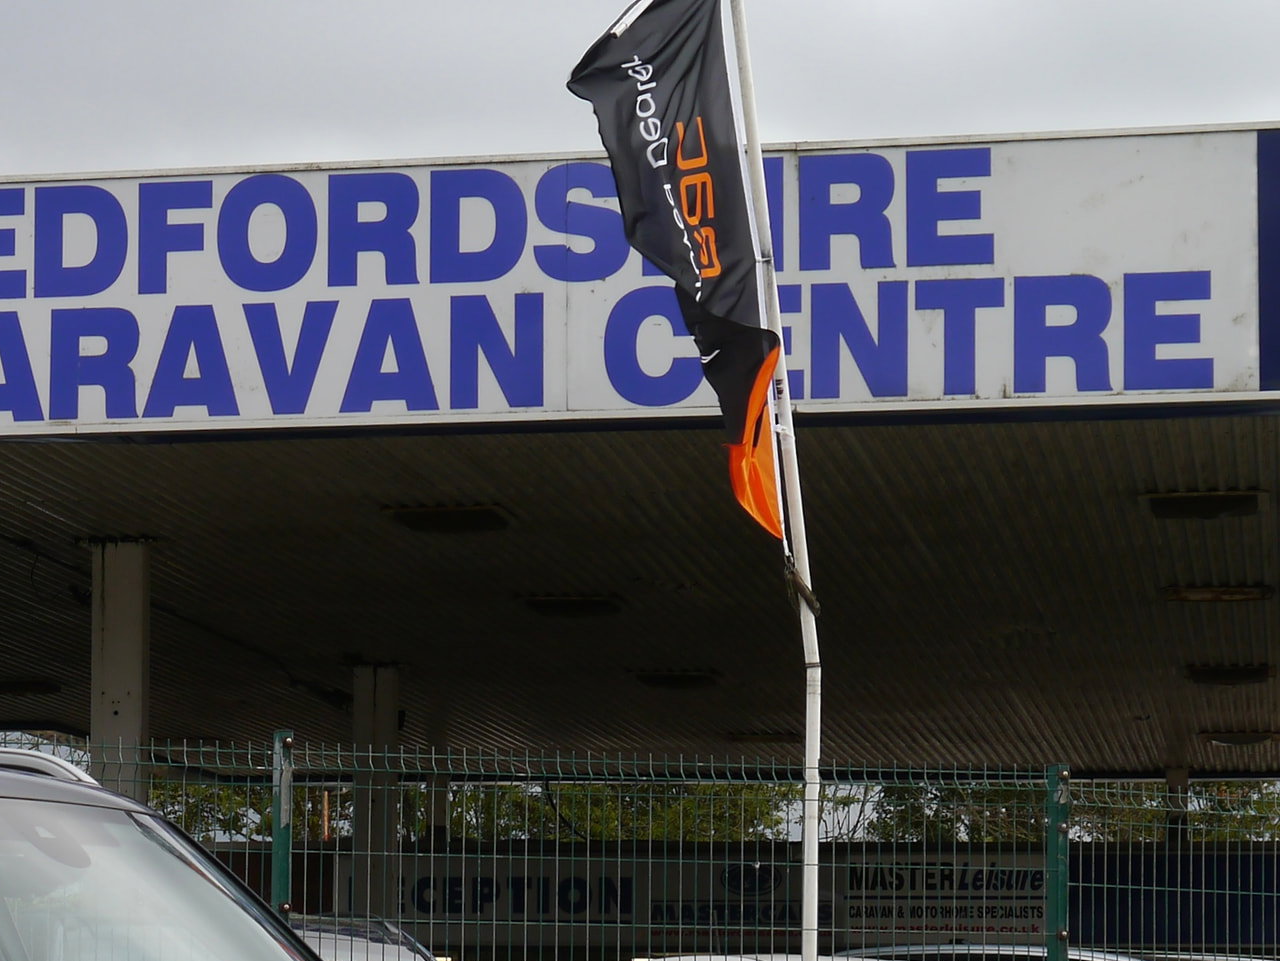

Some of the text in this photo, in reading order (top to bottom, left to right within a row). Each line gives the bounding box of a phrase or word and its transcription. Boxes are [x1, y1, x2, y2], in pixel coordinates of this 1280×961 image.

[348, 876, 634, 915] CEPTION
[651, 904, 833, 922] MASTERCAS
[849, 905, 894, 919] CARAVAN
[977, 905, 1044, 919] SPECIALISTS
